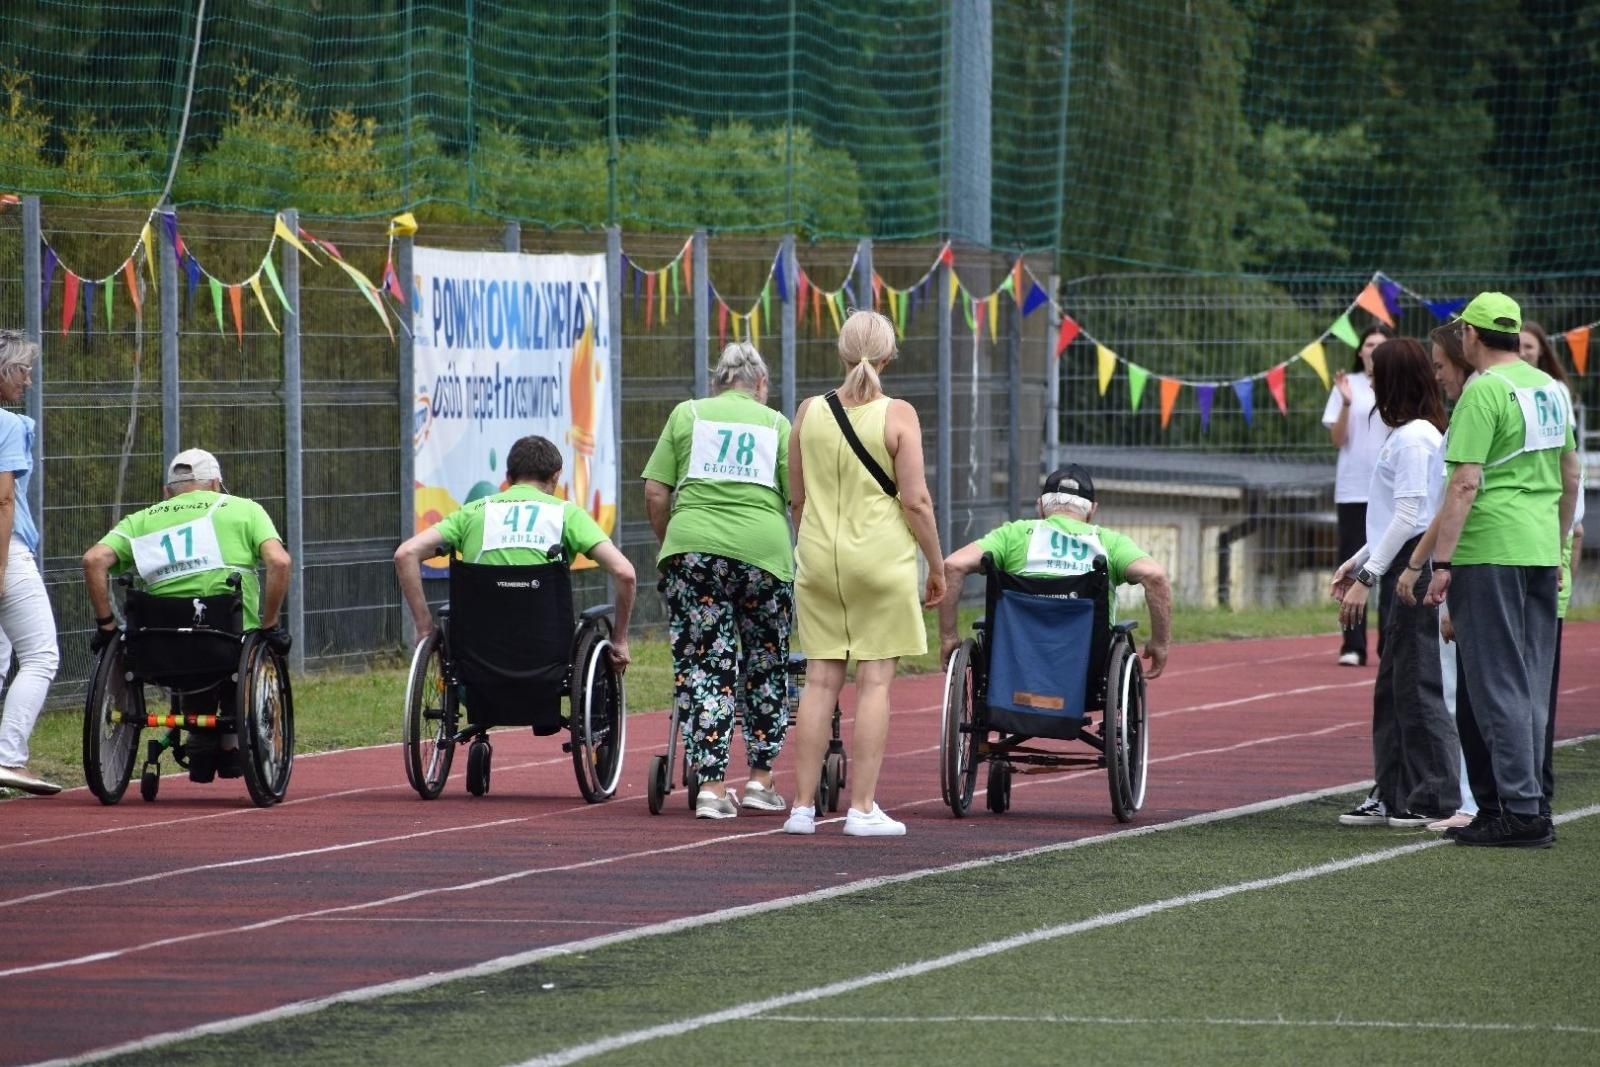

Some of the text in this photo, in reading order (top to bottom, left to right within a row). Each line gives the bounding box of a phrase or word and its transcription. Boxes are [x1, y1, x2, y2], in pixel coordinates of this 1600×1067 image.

[717, 430, 755, 465] 78
[503, 505, 540, 532] 47
[160, 526, 192, 566] 17
